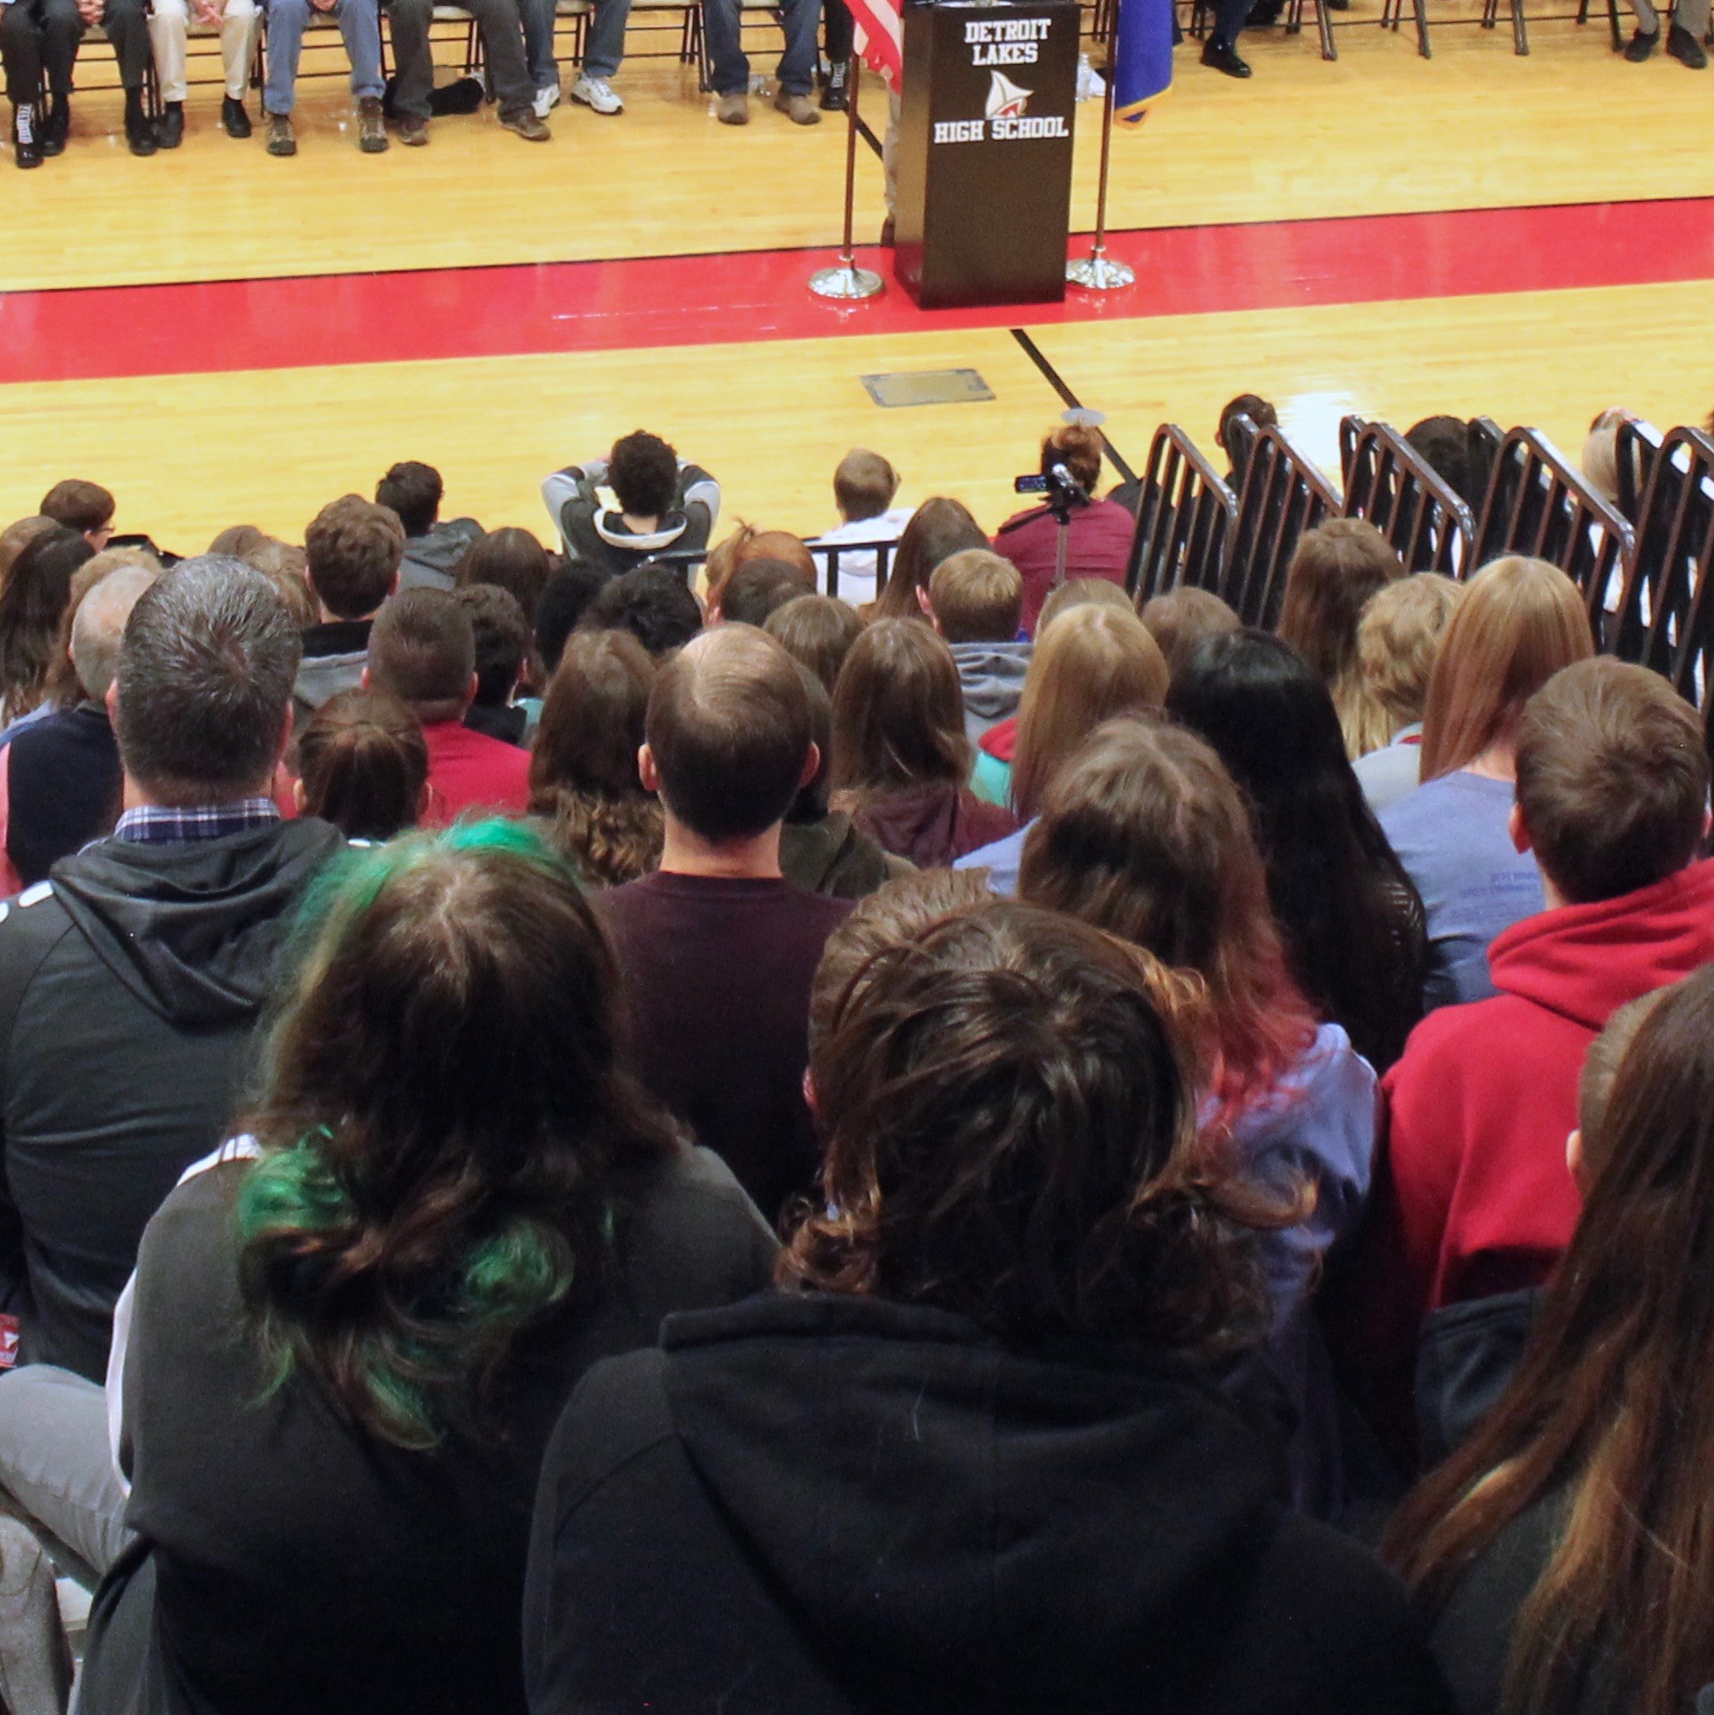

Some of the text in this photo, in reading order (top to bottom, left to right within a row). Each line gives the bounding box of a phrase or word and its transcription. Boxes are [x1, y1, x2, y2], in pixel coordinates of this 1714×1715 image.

[964, 18, 1052, 44] DETROIT
[972, 42, 1038, 67] LAKES
[934, 116, 1070, 144] HIGH SCHOOL
